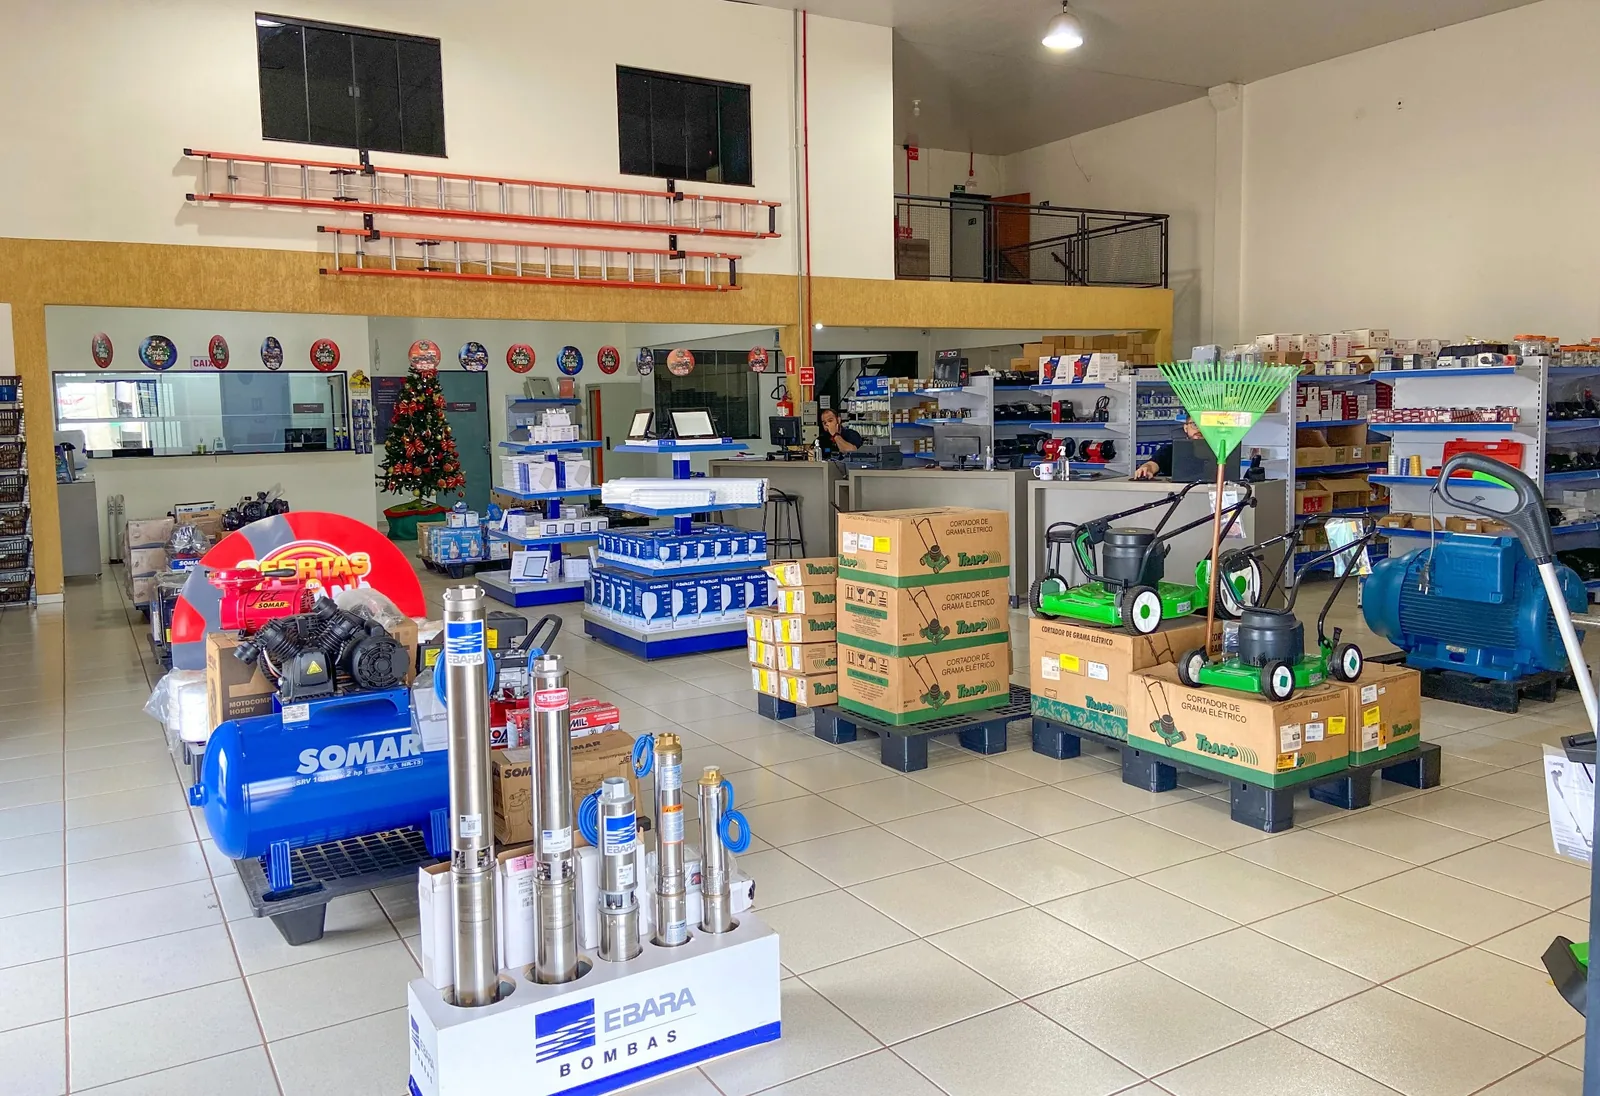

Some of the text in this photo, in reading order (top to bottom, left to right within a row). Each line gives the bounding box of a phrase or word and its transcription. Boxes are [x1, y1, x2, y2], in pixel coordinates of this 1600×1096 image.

[193, 359, 214, 368] CAIX
[950, 518, 980, 528] CORTADOR
[240, 554, 369, 580] FERTAS
[812, 592, 837, 604] TRAP
[946, 590, 990, 601] CORTADOR DE
[942, 602, 964, 611] GRAMA
[1041, 626, 1066, 636] CORTADOR
[1066, 630, 1072, 638] DE
[1072, 632, 1090, 642] GRAMA
[448, 654, 483, 664] EBARA
[946, 652, 990, 666] CORTADOR DE
[942, 666, 964, 676] GRAMA
[813, 682, 838, 695] TRAP
[228, 697, 272, 708] MOTOCOMP
[1186, 694, 1240, 712] CORTADOR DE
[229, 706, 255, 716] HOBBY
[1181, 702, 1247, 724] GRAMA ELÉTRICO
[570, 718, 588, 728] MIL
[571, 740, 601, 750] MAR
[296, 733, 421, 774] SOMAR
[504, 766, 532, 778] SOM
[296, 778, 311, 786] SRV
[606, 843, 636, 855] EBARA
[604, 987, 696, 1033] EBARA
[560, 1029, 678, 1078] BOMBAS
